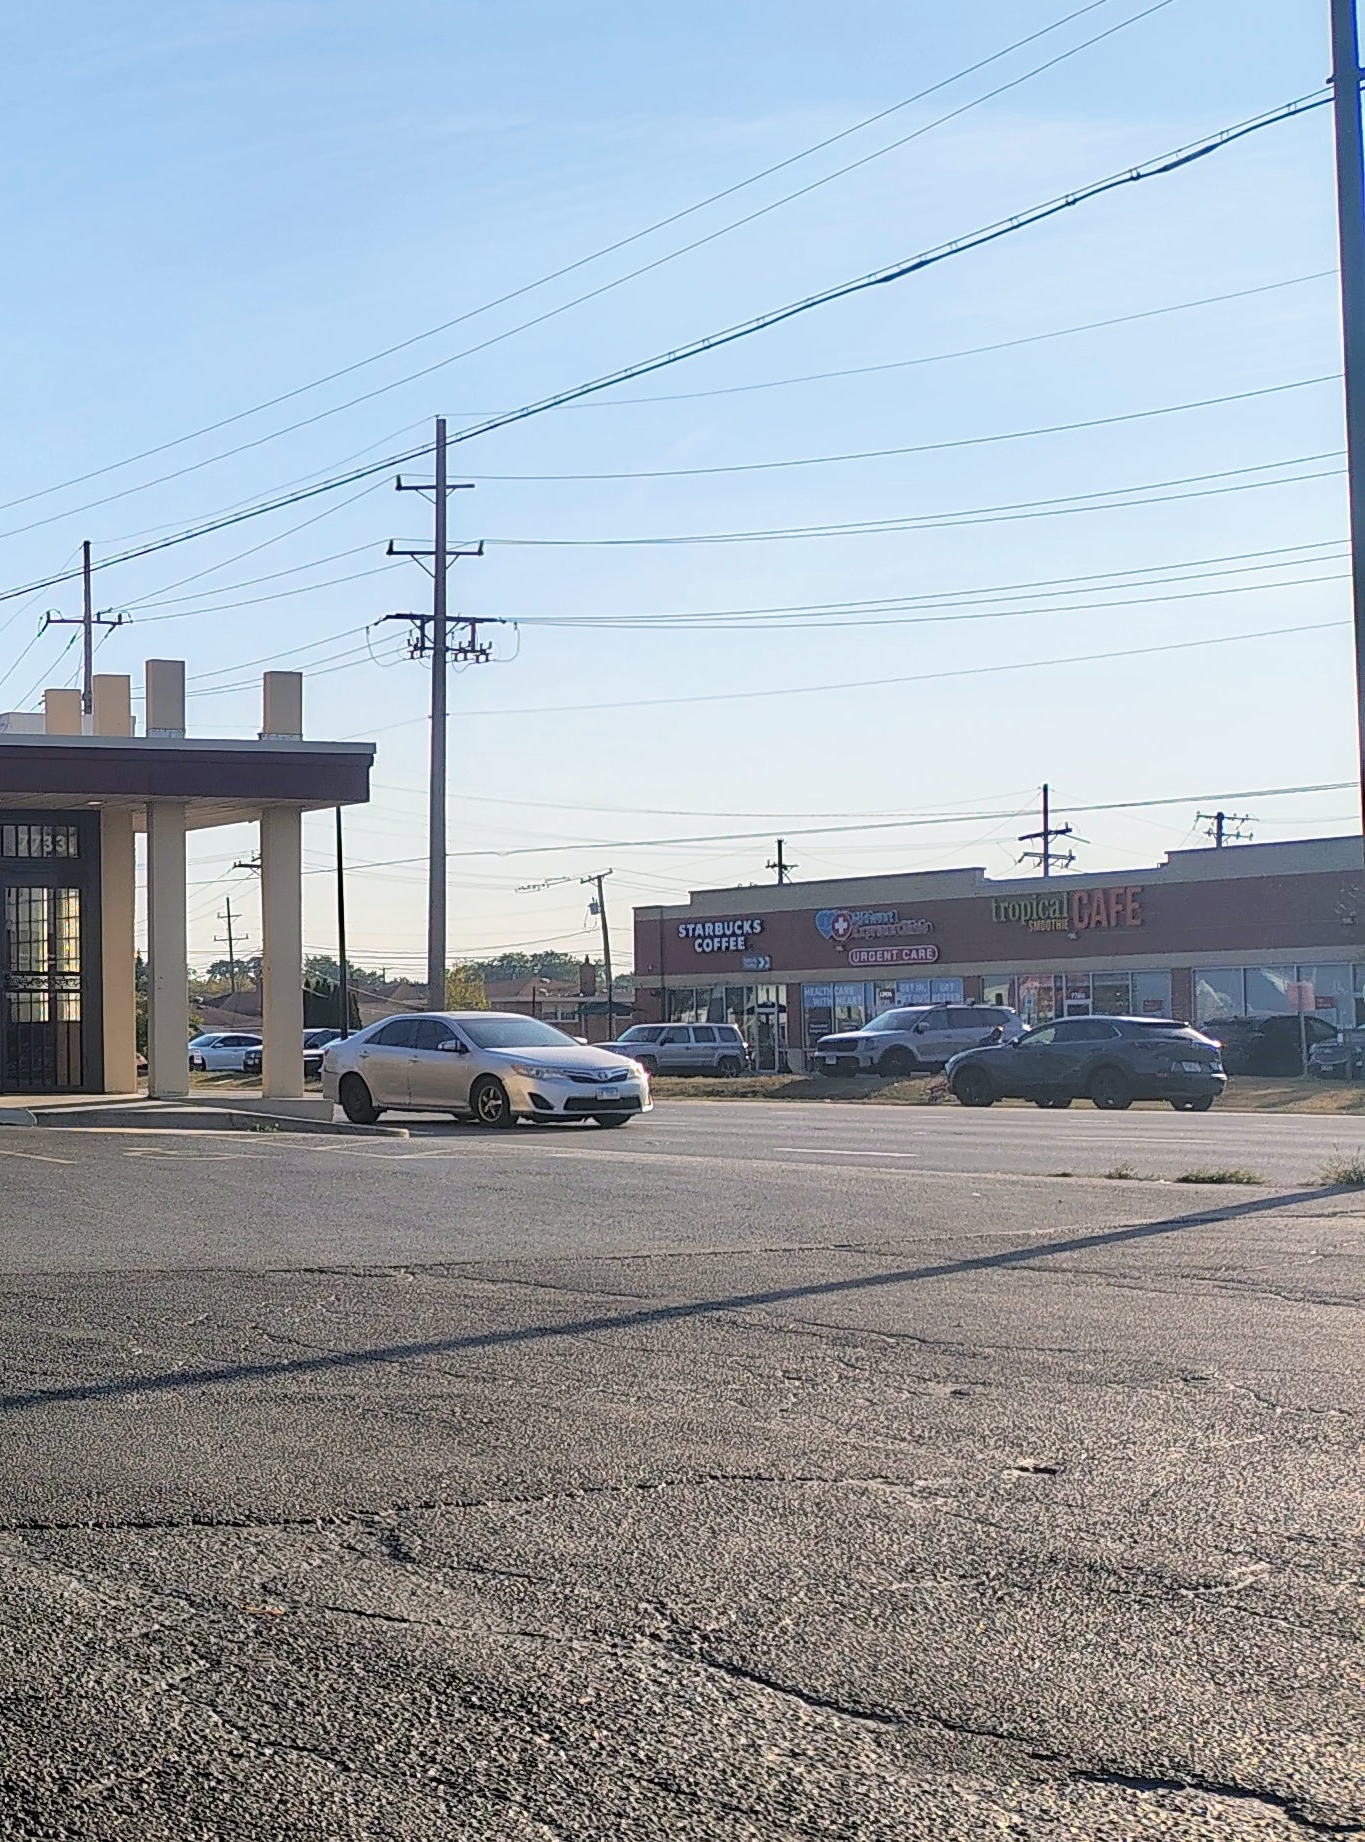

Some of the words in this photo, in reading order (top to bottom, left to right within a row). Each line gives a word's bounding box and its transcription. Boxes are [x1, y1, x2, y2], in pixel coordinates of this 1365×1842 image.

[992, 893, 1069, 925] tropical
[1072, 886, 1142, 930] CAFE
[678, 919, 762, 939] STARBUCKS
[1029, 919, 1069, 933] SMOOTHIE
[694, 936, 746, 953] COFFEE
[852, 949, 900, 963] URGENT
[901, 947, 934, 961] CARE
